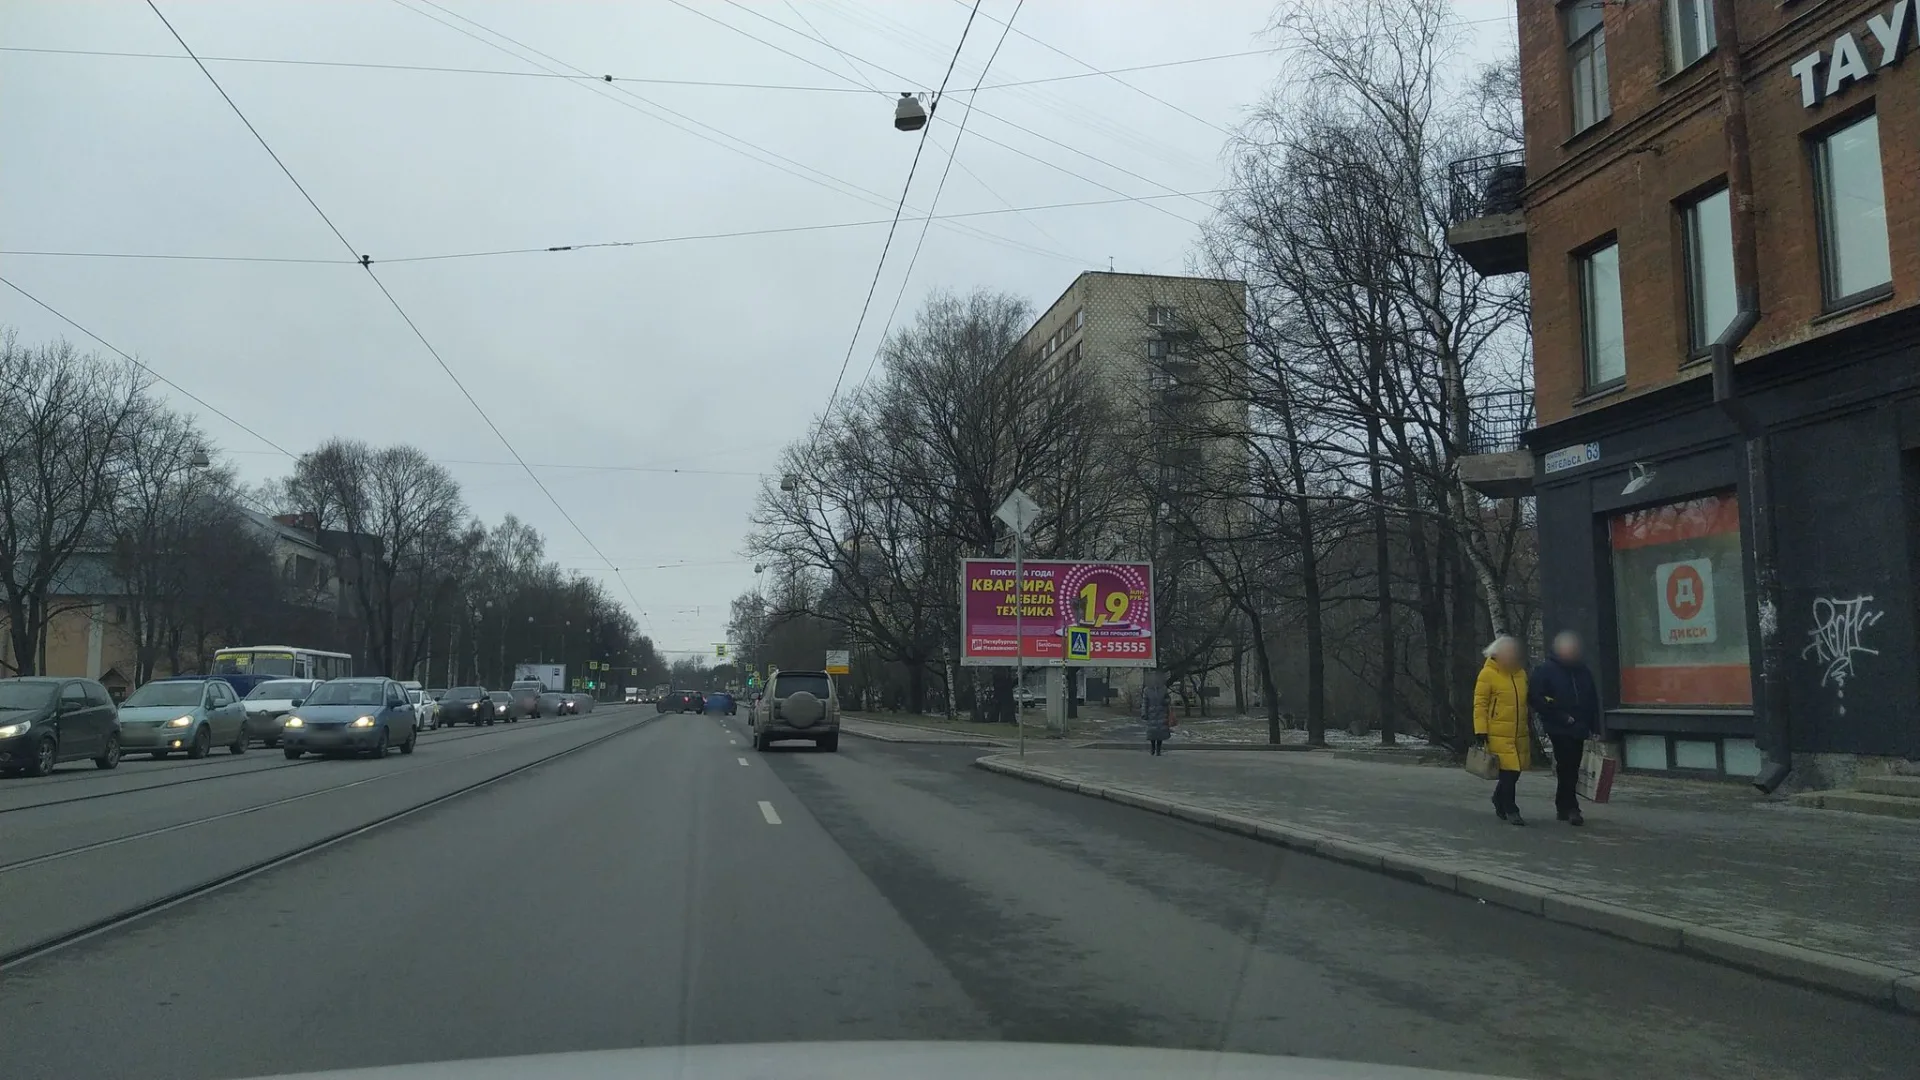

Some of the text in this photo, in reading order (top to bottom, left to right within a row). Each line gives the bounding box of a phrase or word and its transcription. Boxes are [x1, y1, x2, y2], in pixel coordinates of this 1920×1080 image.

[1791, 0, 1920, 108] ТАУ
[1586, 443, 1599, 460] 63
[1546, 456, 1581, 472] ЭНГЕЛЬСА
[1030, 570, 1055, 578] ГОДА!
[972, 579, 1055, 592] КВАРИРА
[1079, 583, 1129, 627] 1,9
[1669, 627, 1708, 641] ДИКСИ
